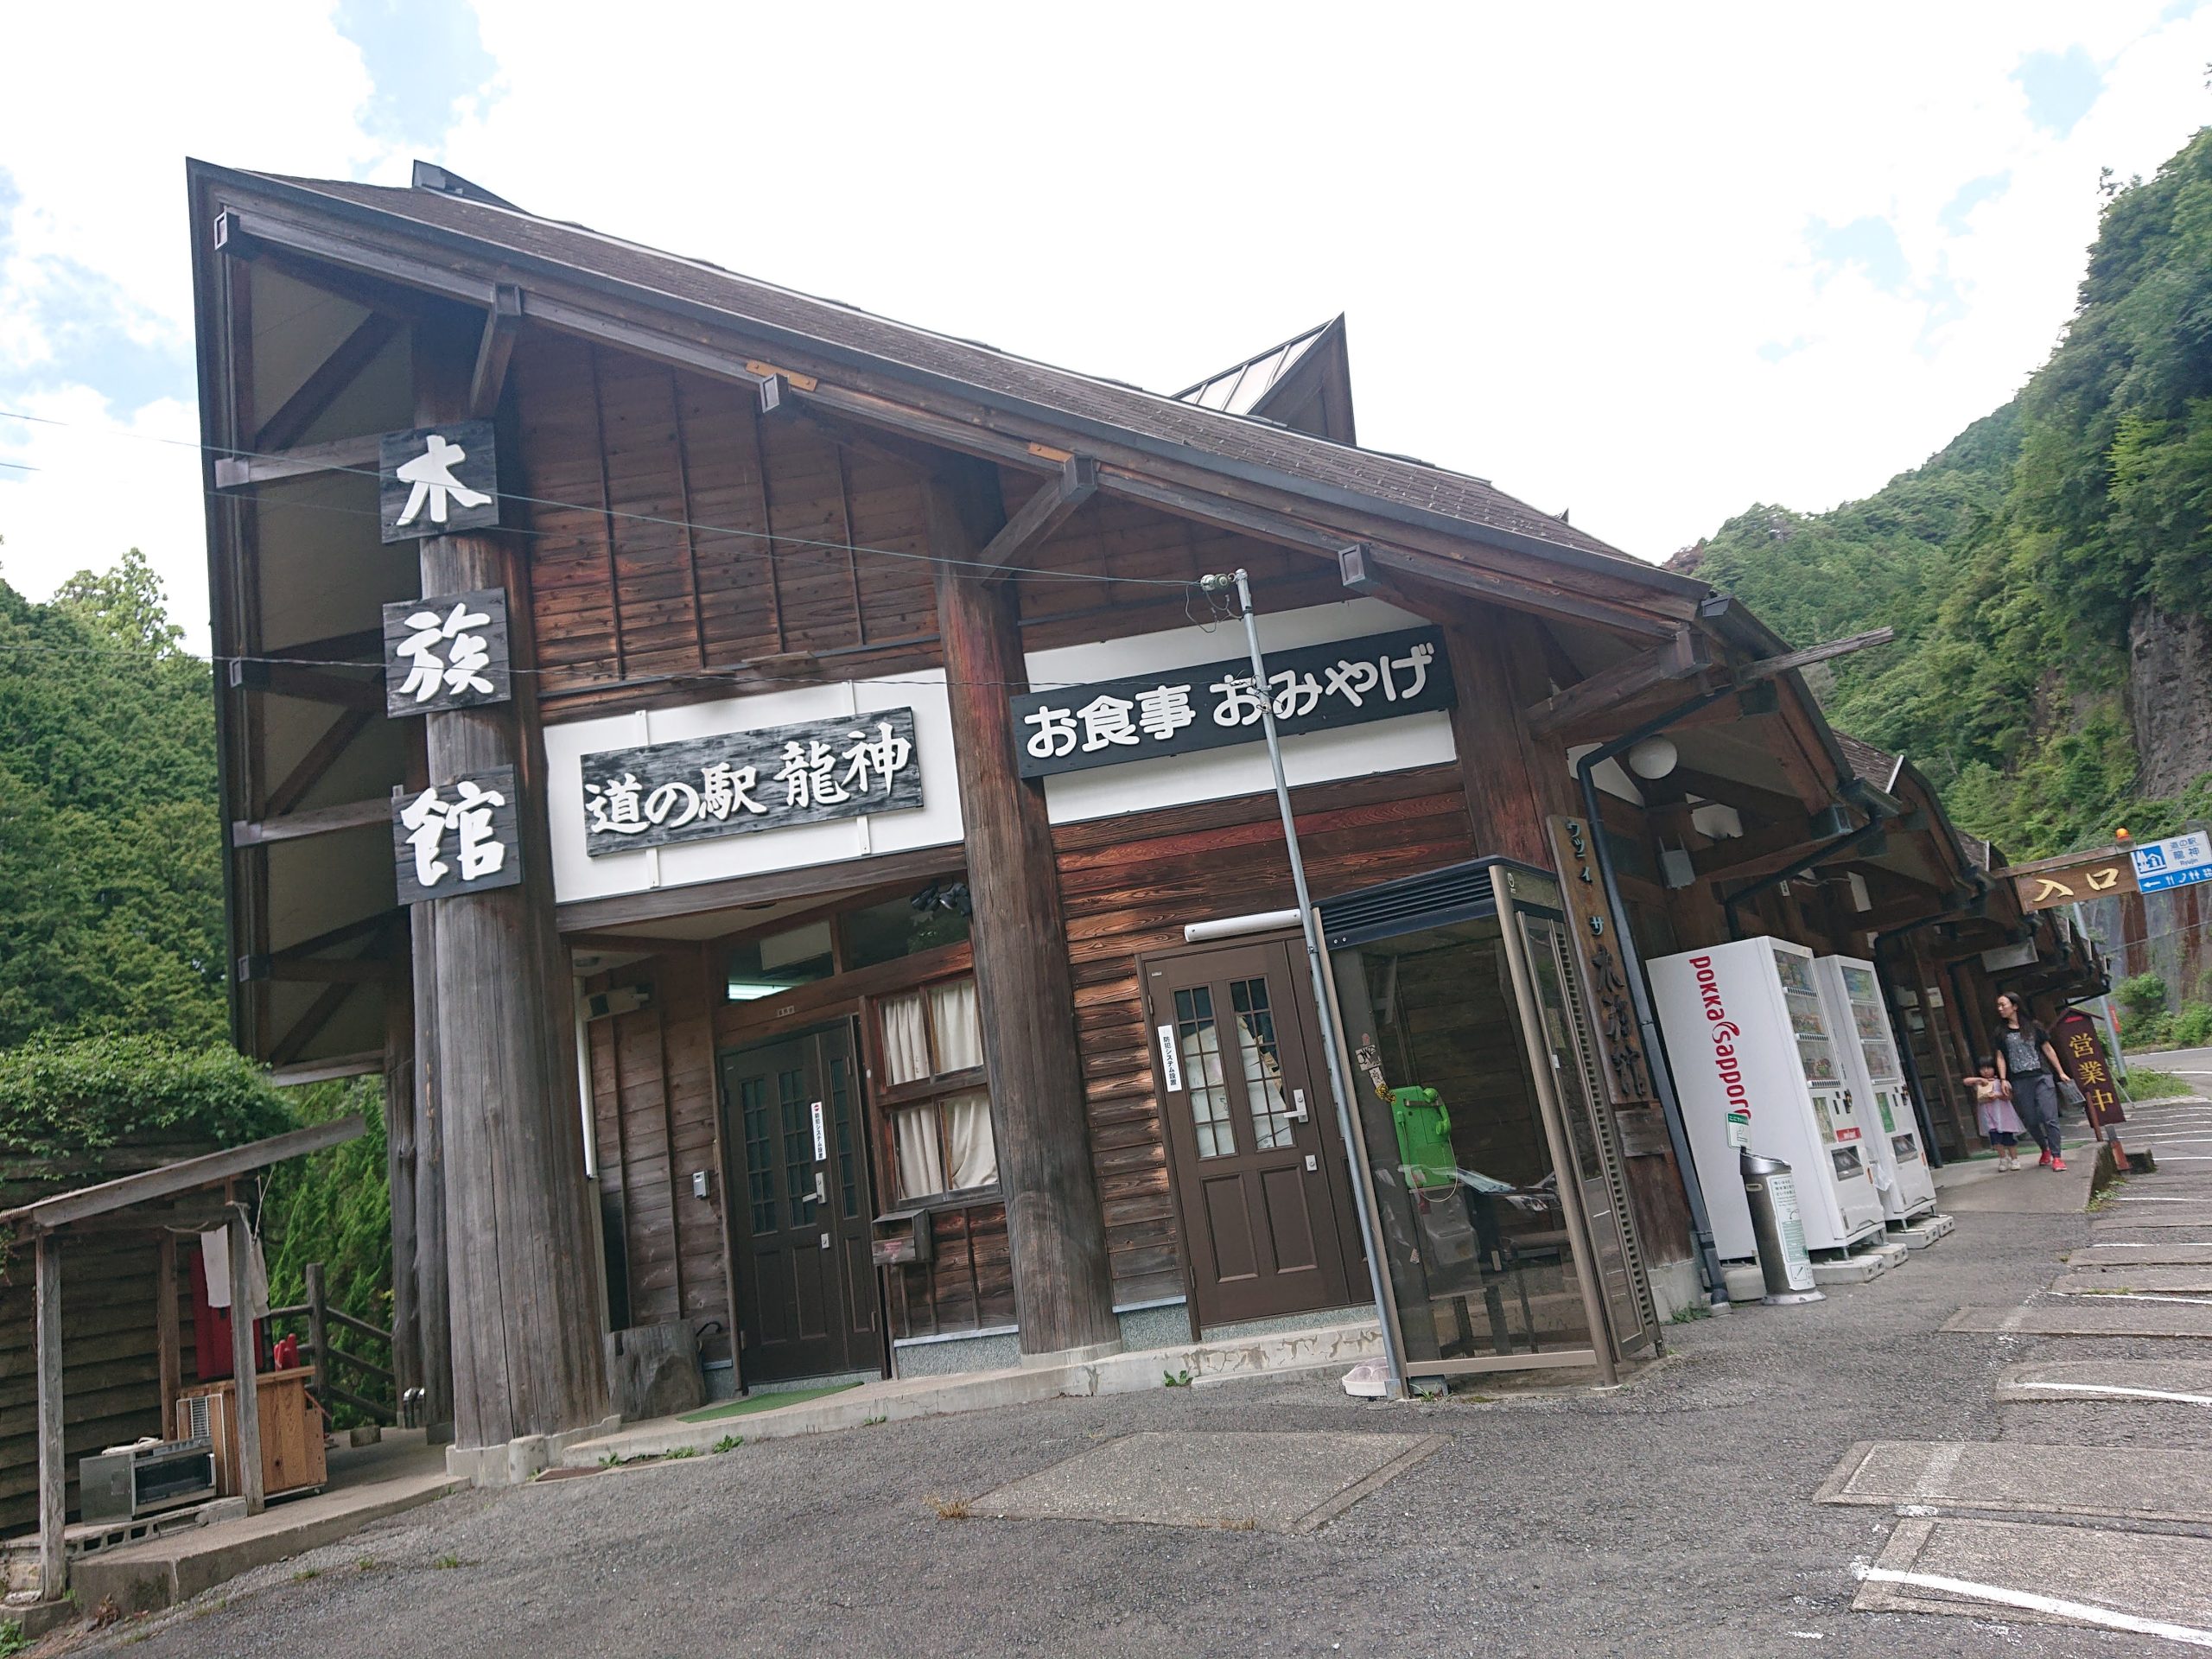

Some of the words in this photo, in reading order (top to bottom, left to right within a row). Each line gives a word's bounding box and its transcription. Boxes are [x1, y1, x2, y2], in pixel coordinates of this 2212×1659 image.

[396, 435, 506, 887] 木族館
[1024, 684, 1197, 757] お食事
[1211, 642, 1435, 727] おみやげ
[585, 763, 767, 836] 道の駅
[774, 722, 912, 809] 龍神
[2032, 868, 2120, 904] 入口
[1163, 1036, 1177, 1086] 防犯システム設置
[2069, 1033, 2115, 1113] 営業中
